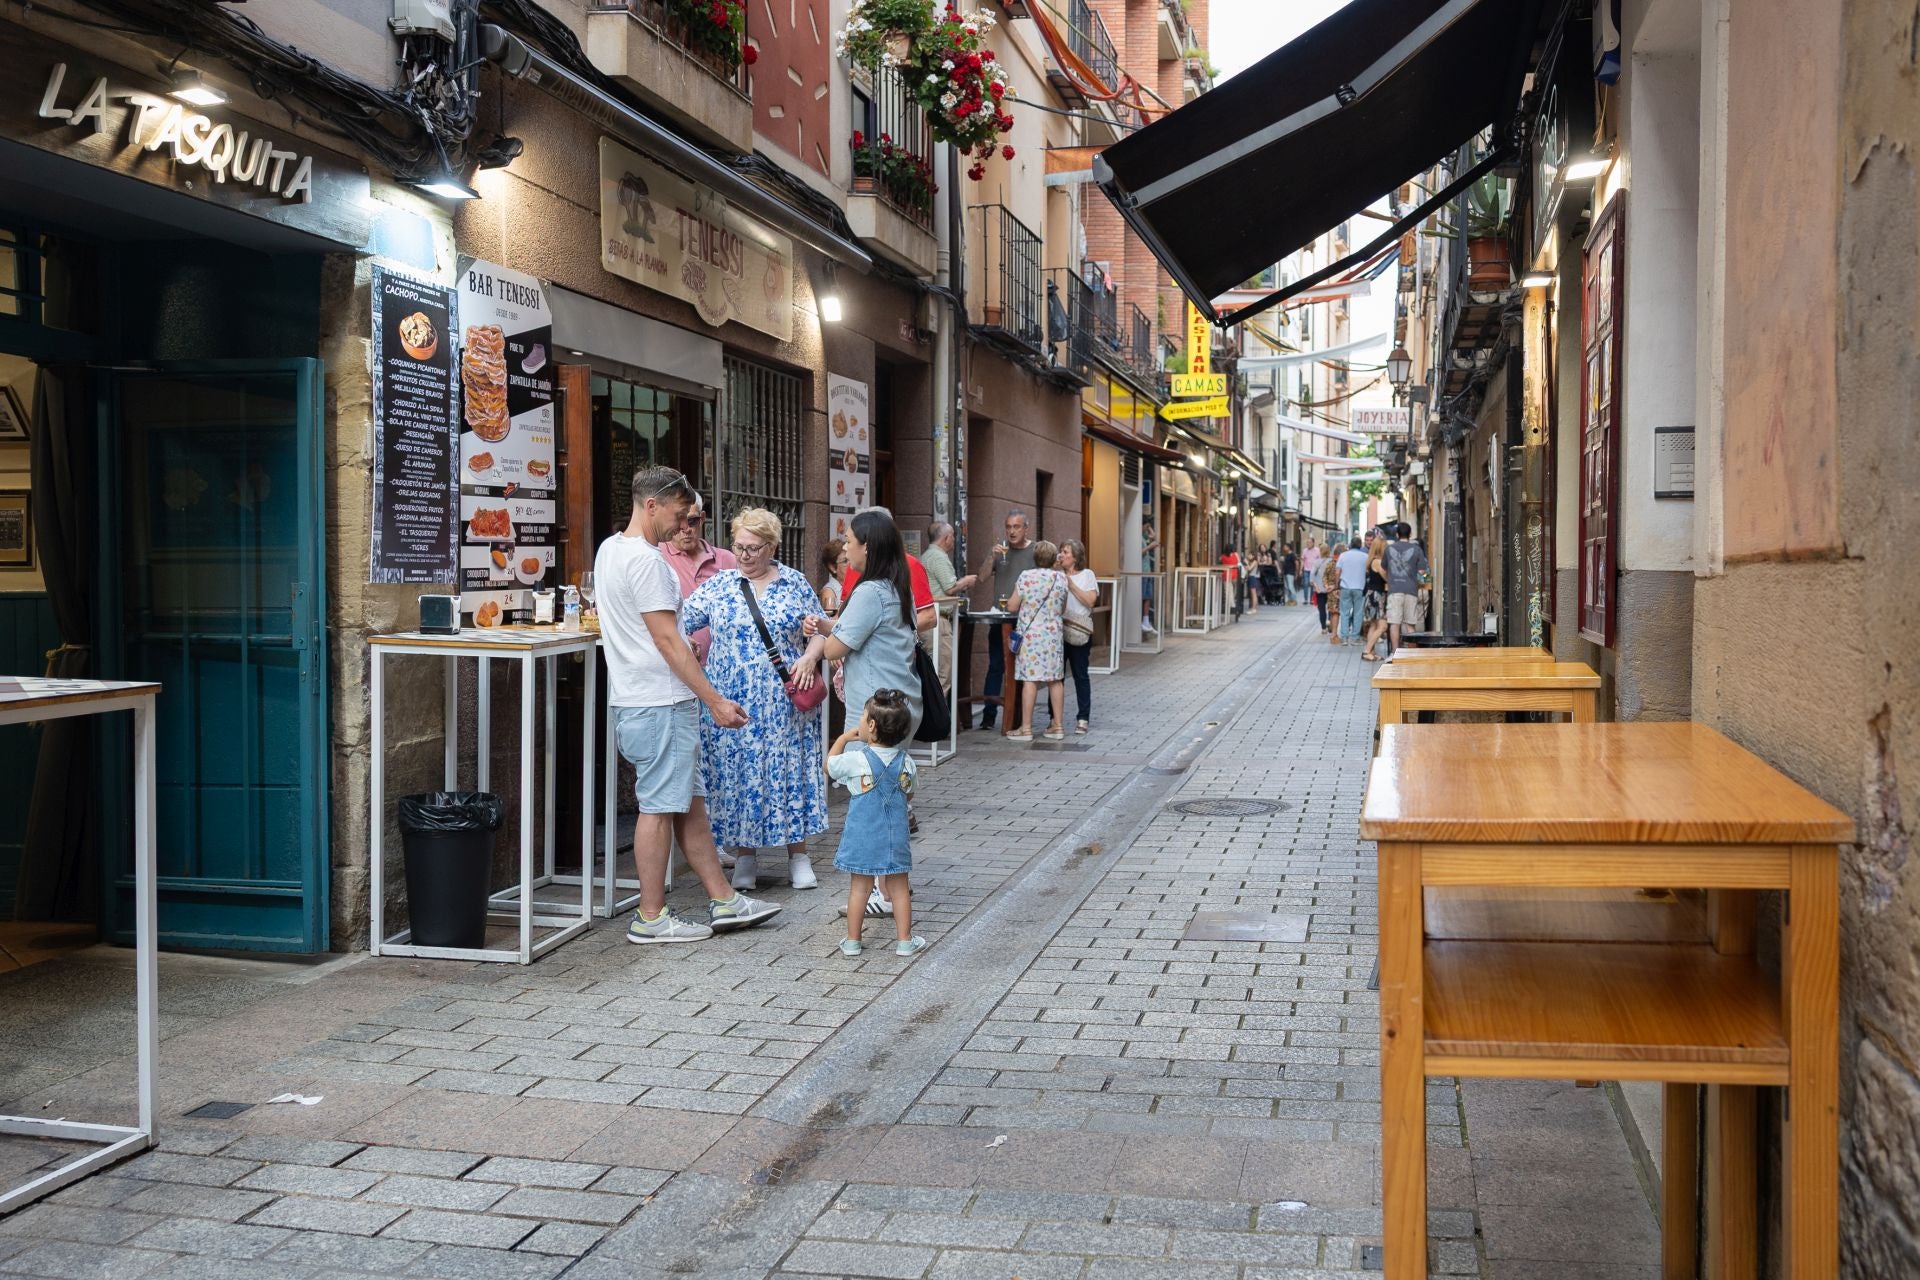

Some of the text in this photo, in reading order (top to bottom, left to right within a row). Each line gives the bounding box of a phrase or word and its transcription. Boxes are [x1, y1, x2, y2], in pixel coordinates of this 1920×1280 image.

[39, 62, 312, 203] LA TASQUITA
[676, 207, 744, 279] TENESSI
[469, 270, 540, 310] BAR TENESSI
[510, 374, 532, 388] ZAPATILLA
[531, 377, 538, 389] DE
[1175, 378, 1224, 393] CAMAS
[423, 481, 430, 489] DE
[474, 486, 490, 496] NORMAL
